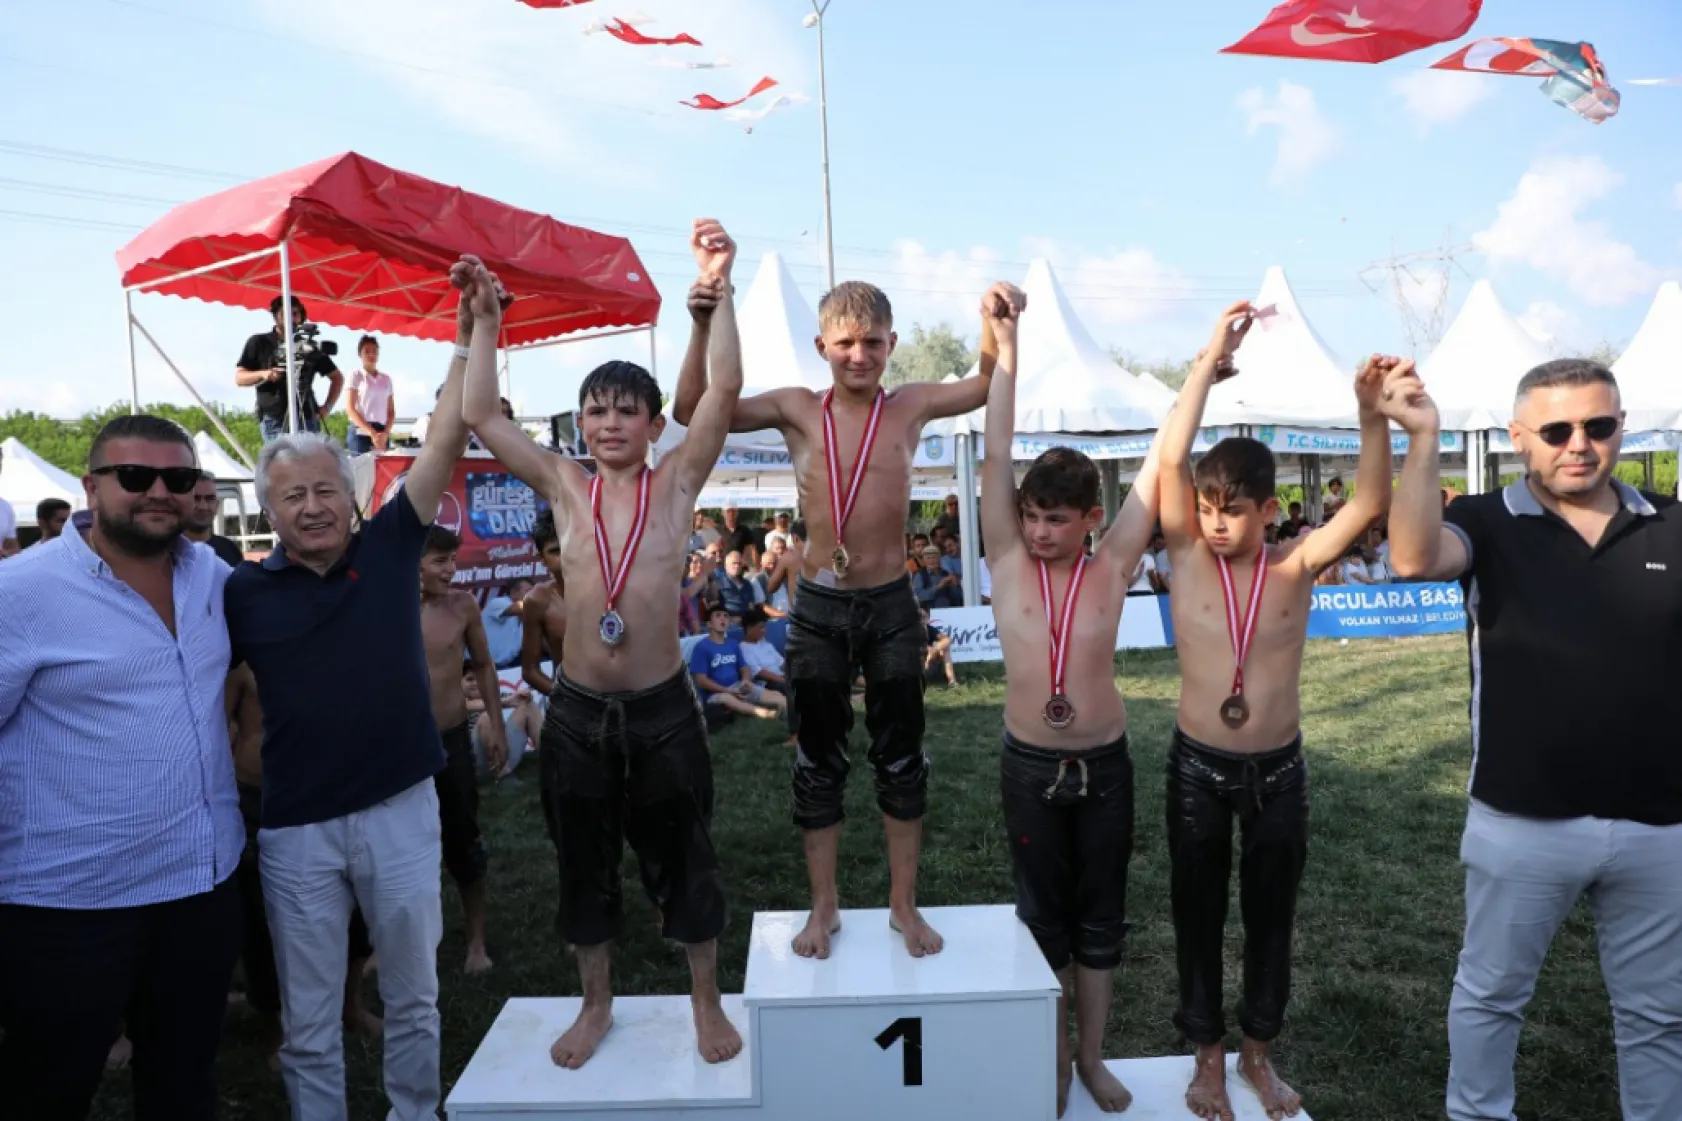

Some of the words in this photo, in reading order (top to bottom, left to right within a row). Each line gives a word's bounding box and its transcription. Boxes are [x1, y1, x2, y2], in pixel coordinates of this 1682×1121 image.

[1420, 588, 1464, 608] BAŞ
[1338, 615, 1380, 627] VOLKAN
[873, 1016, 923, 1087] 1
